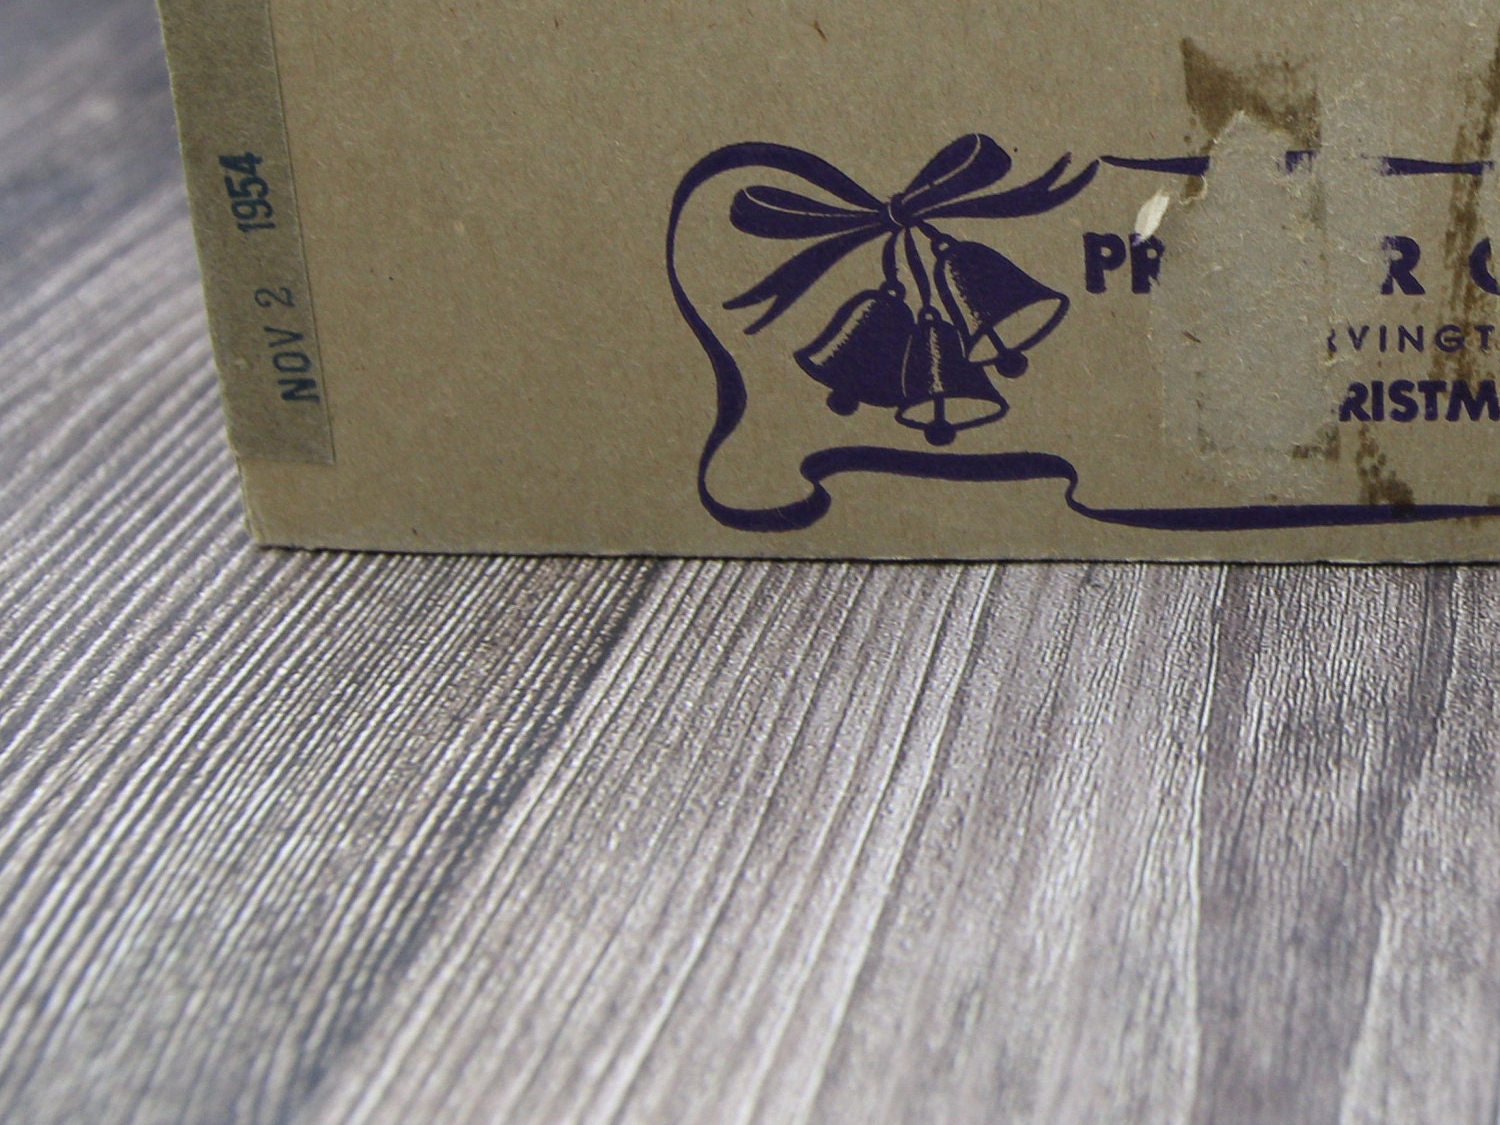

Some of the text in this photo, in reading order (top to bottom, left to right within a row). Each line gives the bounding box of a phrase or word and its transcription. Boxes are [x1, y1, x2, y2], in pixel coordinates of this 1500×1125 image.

[218, 152, 320, 403] NOV 2 1954
